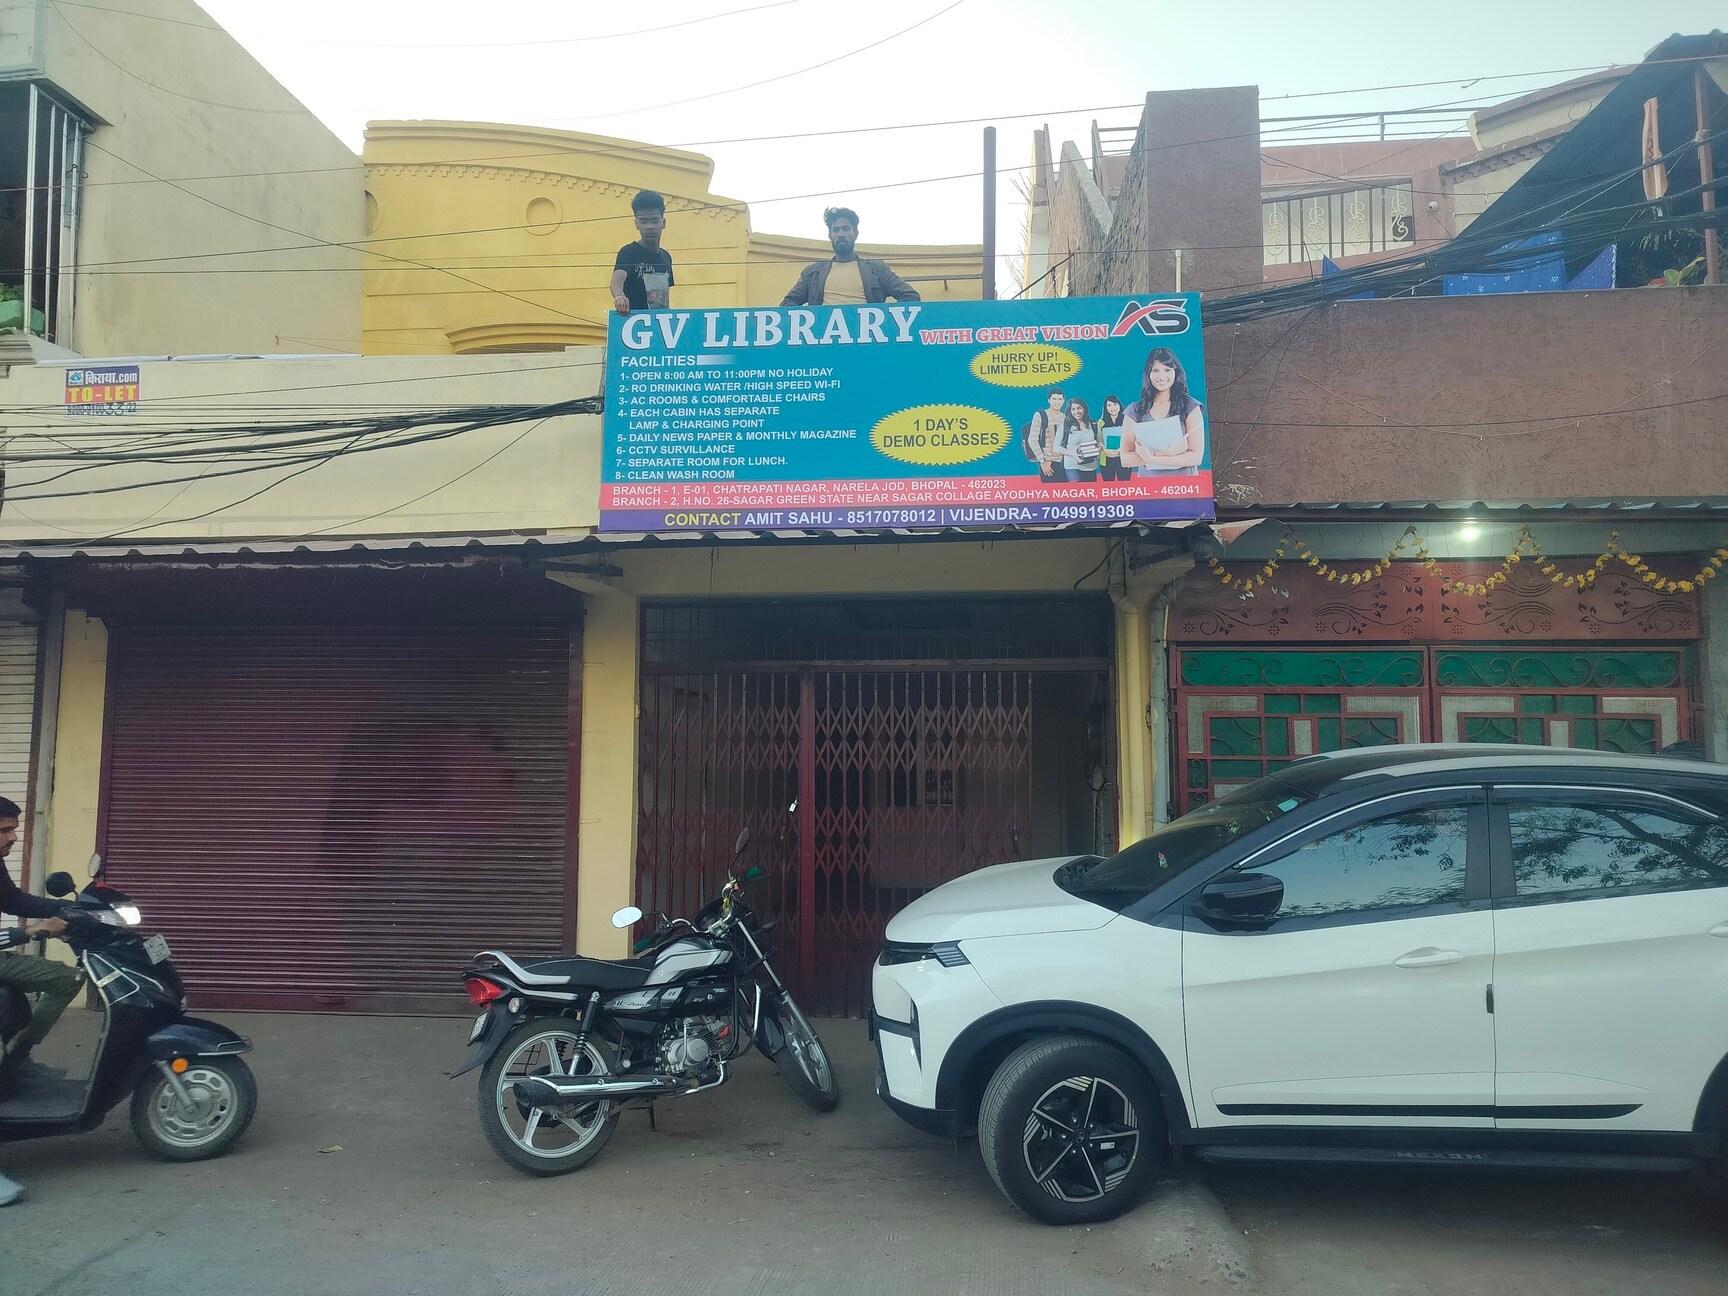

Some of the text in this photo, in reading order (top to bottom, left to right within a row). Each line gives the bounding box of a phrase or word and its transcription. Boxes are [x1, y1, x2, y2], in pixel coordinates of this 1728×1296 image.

[622, 306, 921, 349] GV LIBRARY
[919, 324, 1109, 345] WITH GREAT VISION
[621, 355, 695, 367] FACILITIES
[992, 352, 1058, 363] HURRY UP!
[620, 368, 833, 380] 1- OPEN 8:00 AM TO 11:00PM NO HOLIDAY
[980, 363, 1071, 375] LIMITED SEATS
[619, 385, 629, 393] 2-
[631, 384, 647, 392] RO
[650, 383, 701, 392] DRINKING
[704, 382, 741, 391] WATER
[776, 381, 812, 390] SPEED
[814, 380, 840, 389] WI-FI
[68, 385, 137, 403] TO-LET
[619, 393, 825, 405] 3- AC ROOMS & COMFORTABLE CHAIRS
[618, 406, 779, 417] 4- EACH CABIN HAS SEPARATE
[629, 419, 765, 429] LAMP & CHARGING POINT
[914, 419, 919, 431] 1
[617, 430, 856, 442] 5- DAILY NEWS PAPER & MONTHLY MAGAZINE
[883, 432, 999, 448] DEMO CLASSES
[616, 445, 735, 455] 6- CCTV SURVILLANCE
[616, 456, 788, 467] 7- SEPARATE ROOM FOR LUNCH.
[615, 470, 734, 480] 8- CLEAN WASH ROOM
[613, 486, 661, 495] BRANCH
[671, 486, 680, 495] 1,
[713, 484, 782, 494] CHATRAPATI
[786, 483, 829, 493] NAGAR,
[833, 482, 879, 492] NARELA
[882, 482, 908, 492] JOD,
[912, 481, 958, 490] BHOPAL
[968, 479, 1006, 489] 462023
[613, 497, 660, 506] BRANCH
[670, 497, 679, 507] 2,
[776, 495, 815, 504] GREEN
[819, 494, 854, 503] STATE
[857, 493, 889, 503] NEAR
[892, 492, 932, 502] SAGAR
[936, 491, 991, 501] COLLAGE
[994, 490, 1050, 500] AYODHYA
[1052, 488, 1098, 499] NAGAR,
[1102, 487, 1151, 497] BHOPAL
[1161, 485, 1199, 495] 462041
[665, 513, 741, 526] CONTACT
[744, 512, 784, 525] AMIT
[788, 512, 832, 524] SAHU
[847, 509, 936, 523] 8517078012
[1042, 505, 1134, 519] 7049919308
